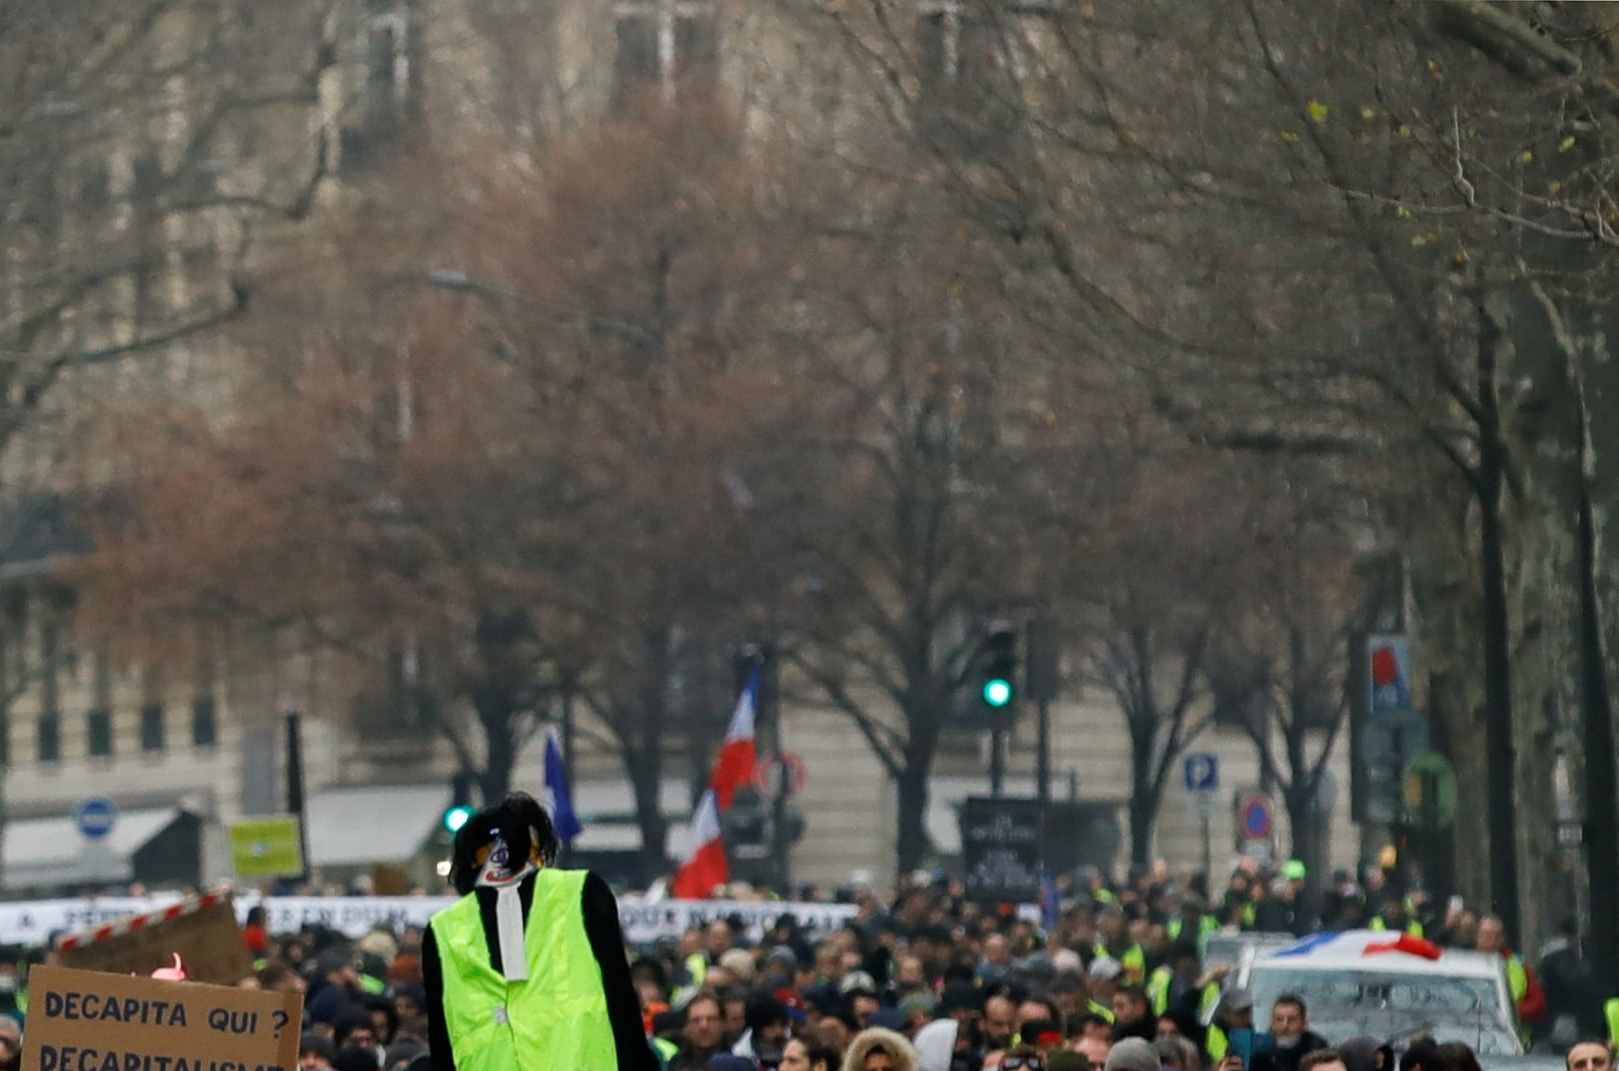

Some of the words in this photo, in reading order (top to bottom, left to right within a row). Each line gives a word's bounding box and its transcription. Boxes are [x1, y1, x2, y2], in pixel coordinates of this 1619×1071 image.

[44, 991, 187, 1027] DECAPITA
[208, 1008, 257, 1034] QUI
[271, 1009, 289, 1039] ?
